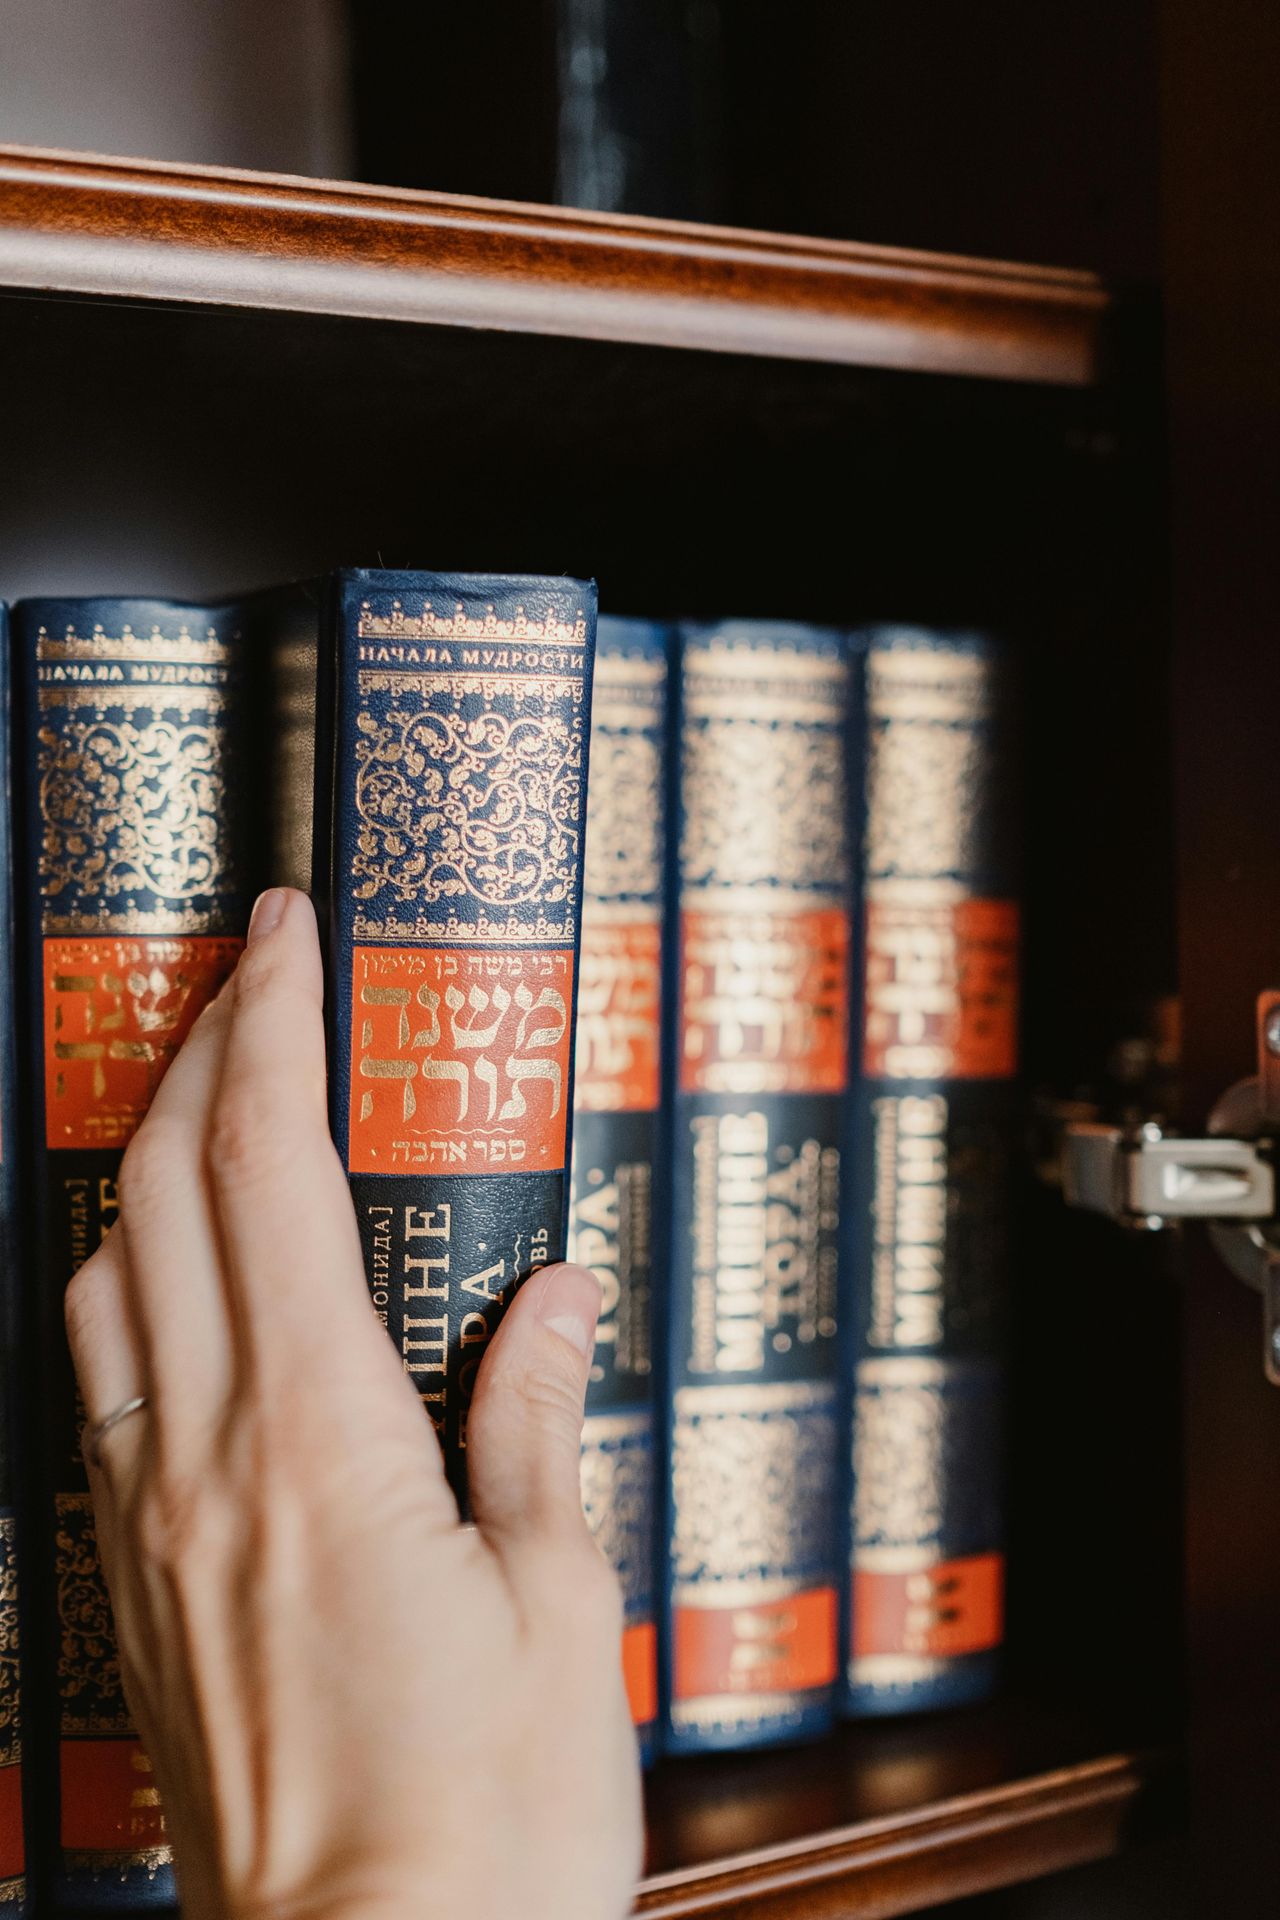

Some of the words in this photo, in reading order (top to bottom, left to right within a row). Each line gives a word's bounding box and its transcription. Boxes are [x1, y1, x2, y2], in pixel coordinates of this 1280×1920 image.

[359, 646, 453, 664] НАЧАЛА
[462, 650, 584, 669] МУДРОСТИ
[360, 953, 426, 979] מימון
[434, 954, 459, 980] בן
[467, 955, 523, 976] משה
[532, 954, 568, 975] רבי
[51, 966, 194, 1034] שנה
[360, 980, 567, 1051] משנה
[359, 1053, 562, 1123] תורה
[392, 1139, 467, 1163] אהבה
[472, 1138, 527, 1163] ספר
[368, 1205, 393, 1337] МОНИДА]
